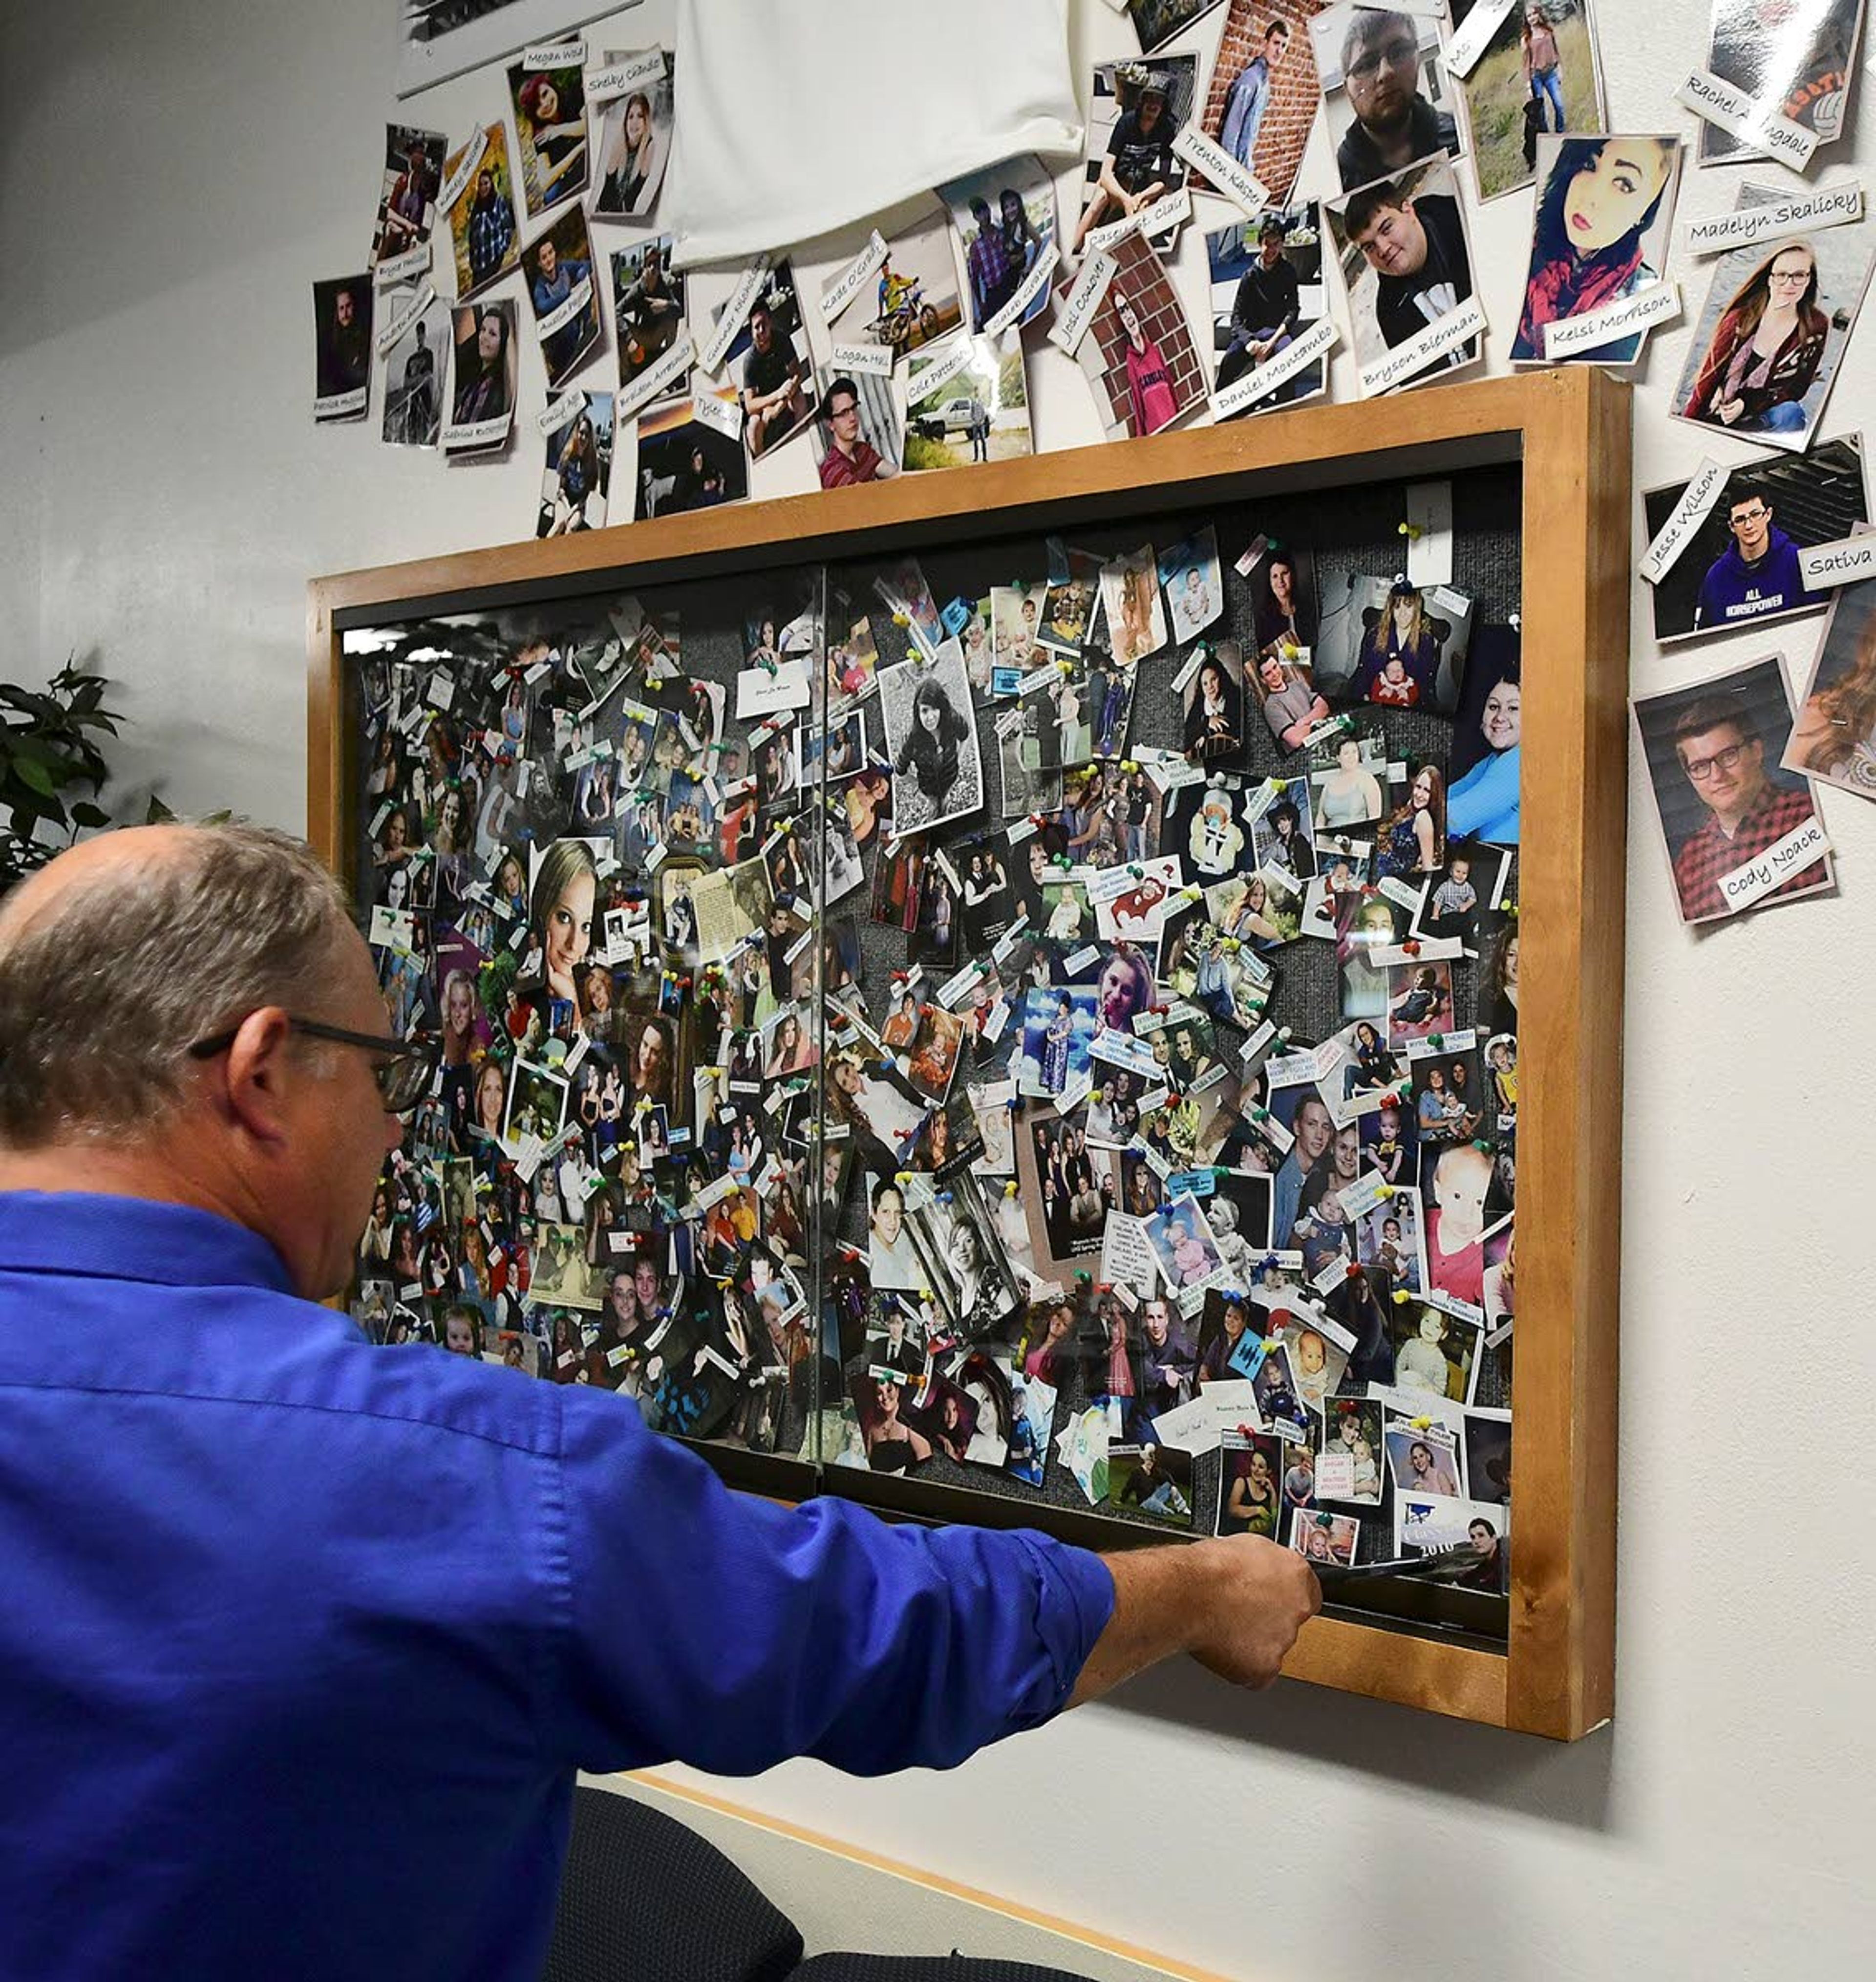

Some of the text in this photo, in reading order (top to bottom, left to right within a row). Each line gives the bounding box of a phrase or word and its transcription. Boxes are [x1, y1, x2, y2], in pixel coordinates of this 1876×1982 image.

[589, 74, 624, 90] Shelby
[1685, 77, 1736, 113] Rachel
[1185, 133, 1261, 206] Trenton Kasper
[1135, 215, 1151, 228] St.
[1155, 197, 1184, 219] Clair
[1691, 192, 1858, 240] Madelyn Skalicky
[823, 285, 848, 311] Kade
[1064, 259, 1106, 345] Josi Conover
[1553, 296, 1671, 345] Kelsi Morrison
[835, 348, 868, 365] Logan
[1364, 312, 1480, 385] Bryson Bierman
[1218, 376, 1262, 409] Daniel
[1265, 326, 1332, 384] Montambo
[908, 381, 929, 397] Cole
[1650, 469, 1718, 573] Jesse Wilson
[1808, 549, 1871, 575] Sativa
[1726, 594, 1783, 617] HORSEPOWER
[1745, 589, 1761, 601] ALL
[1727, 829, 1821, 897] Cody Noack
[1420, 1543, 1454, 1558] 2010
